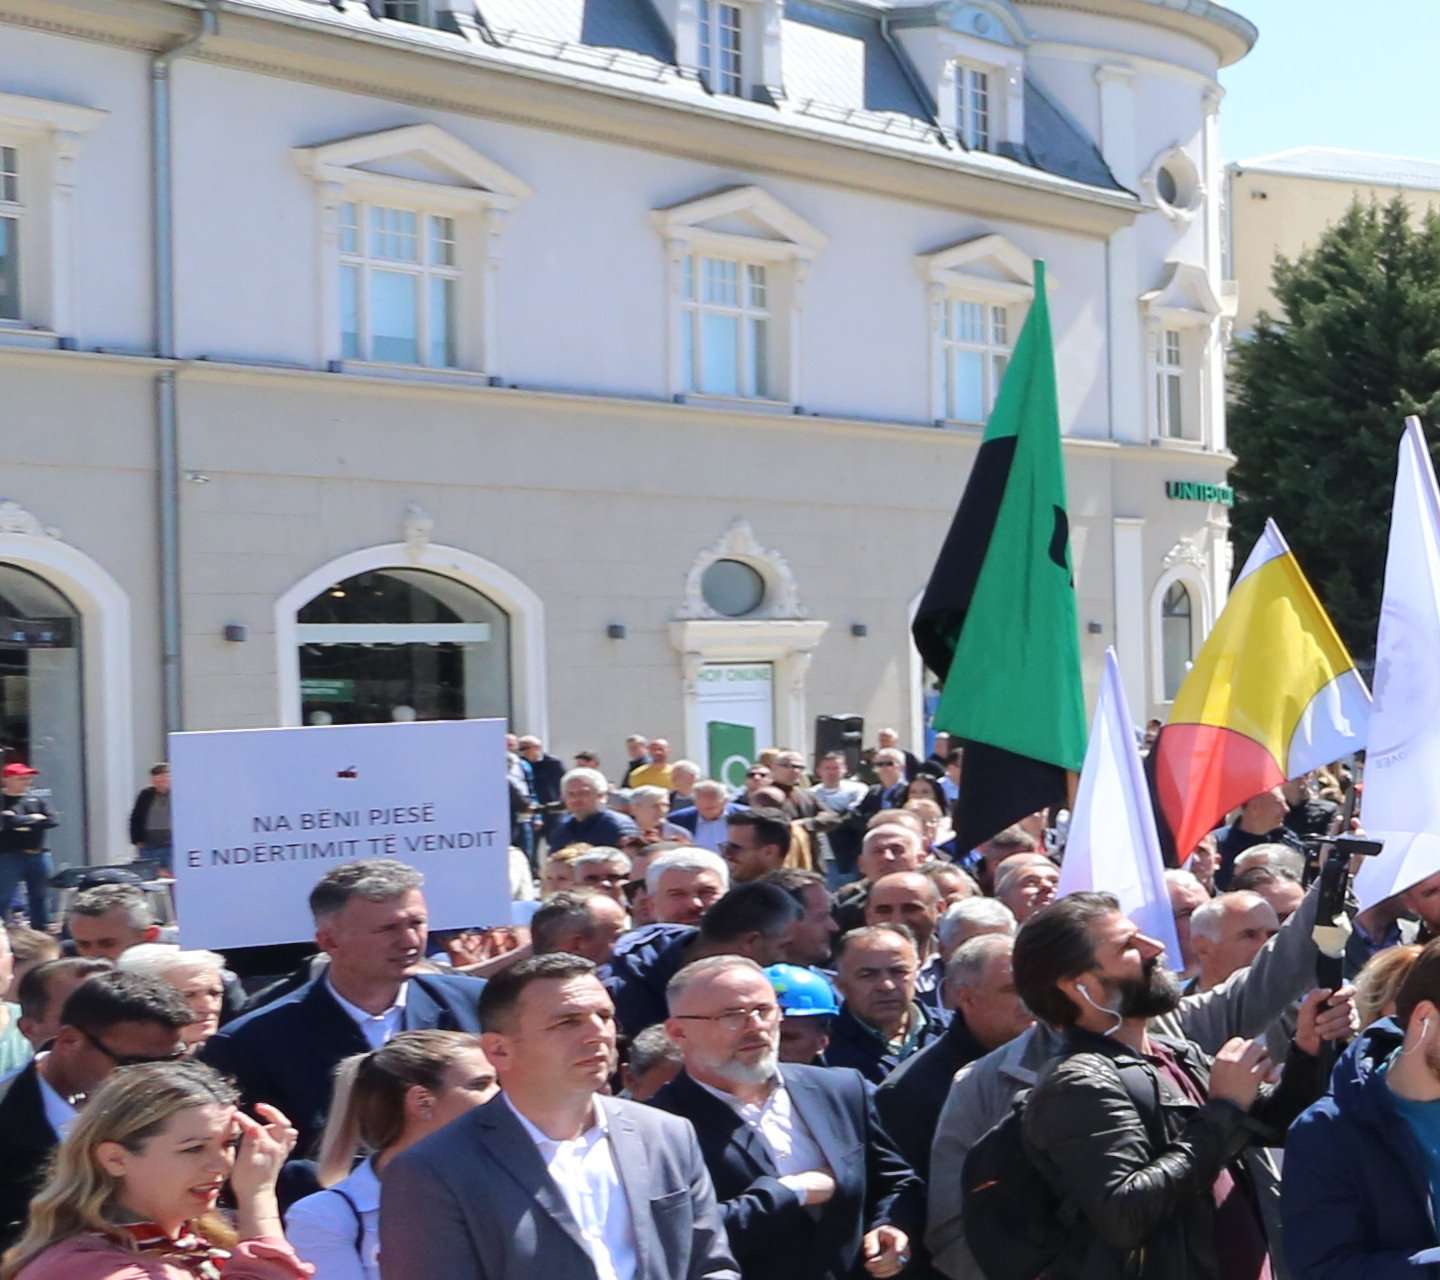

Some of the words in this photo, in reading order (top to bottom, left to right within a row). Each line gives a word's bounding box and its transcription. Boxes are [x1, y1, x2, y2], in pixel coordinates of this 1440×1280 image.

[252, 814, 292, 833] NA
[299, 808, 360, 831] BËNI
[368, 802, 435, 826] PJESË
[187, 849, 202, 868] E
[211, 839, 360, 867] NDËRTIMIT
[368, 833, 396, 855] TË
[404, 830, 498, 852] VENDIT
